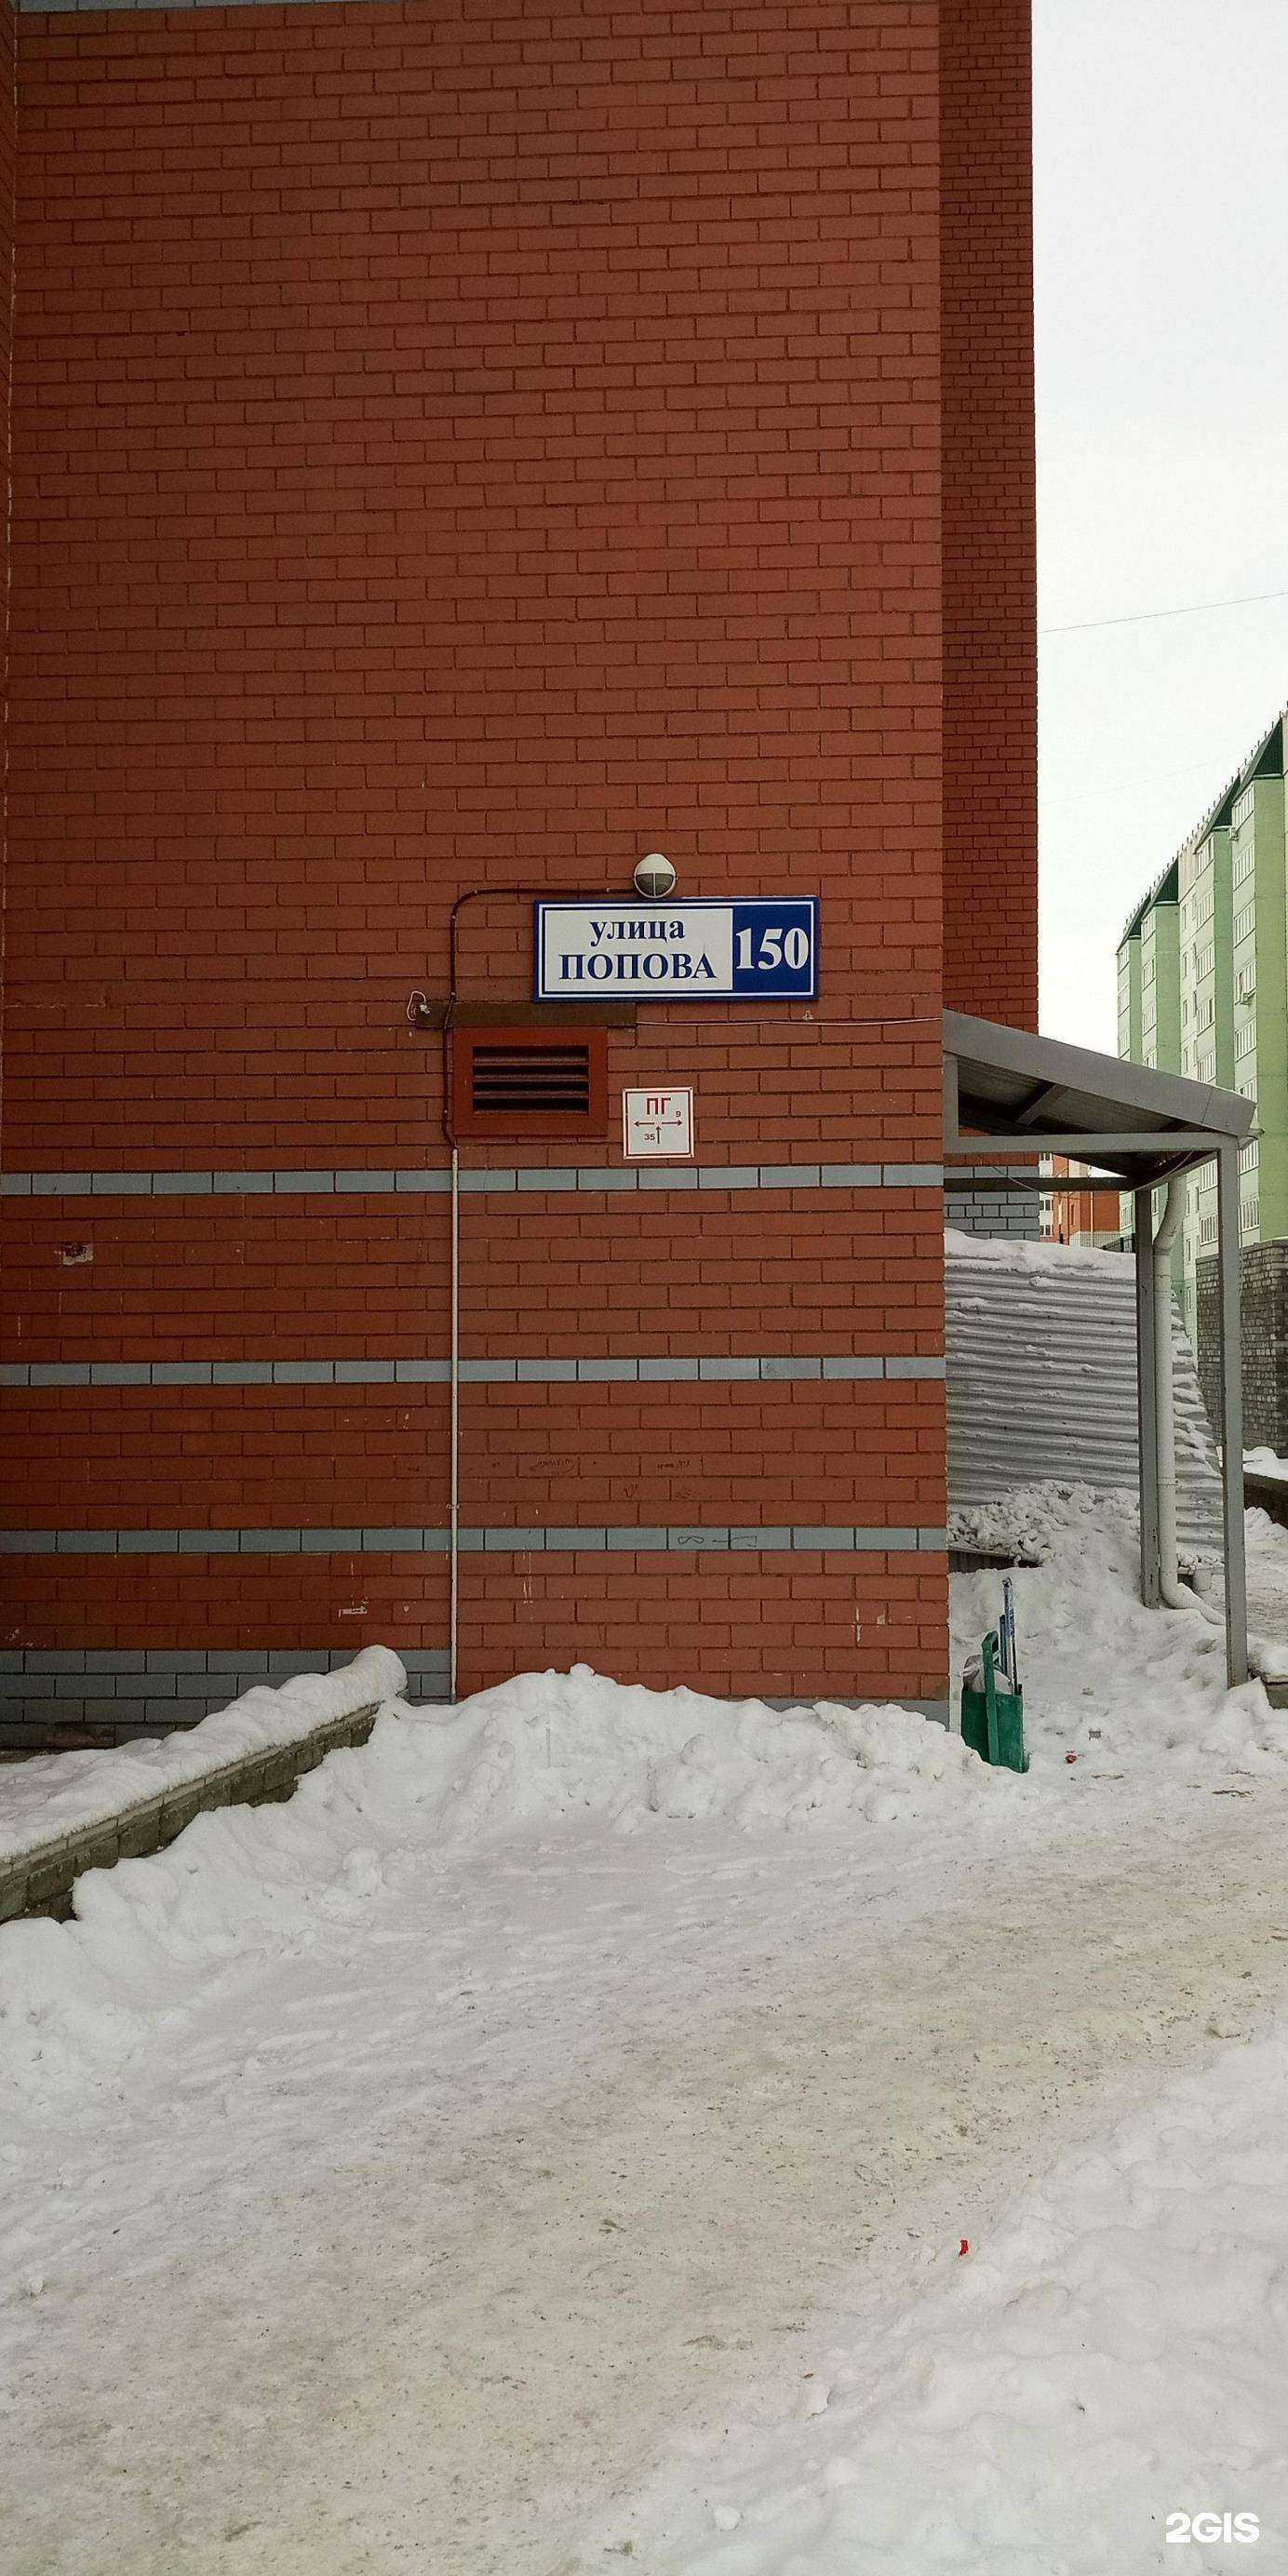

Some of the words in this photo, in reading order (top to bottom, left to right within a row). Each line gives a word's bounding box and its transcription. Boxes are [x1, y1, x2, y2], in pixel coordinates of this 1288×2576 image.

[589, 918, 685, 946] улица
[735, 927, 810, 970] 150
[560, 952, 718, 980] ПОПОВА
[646, 1097, 671, 1115] ПГ
